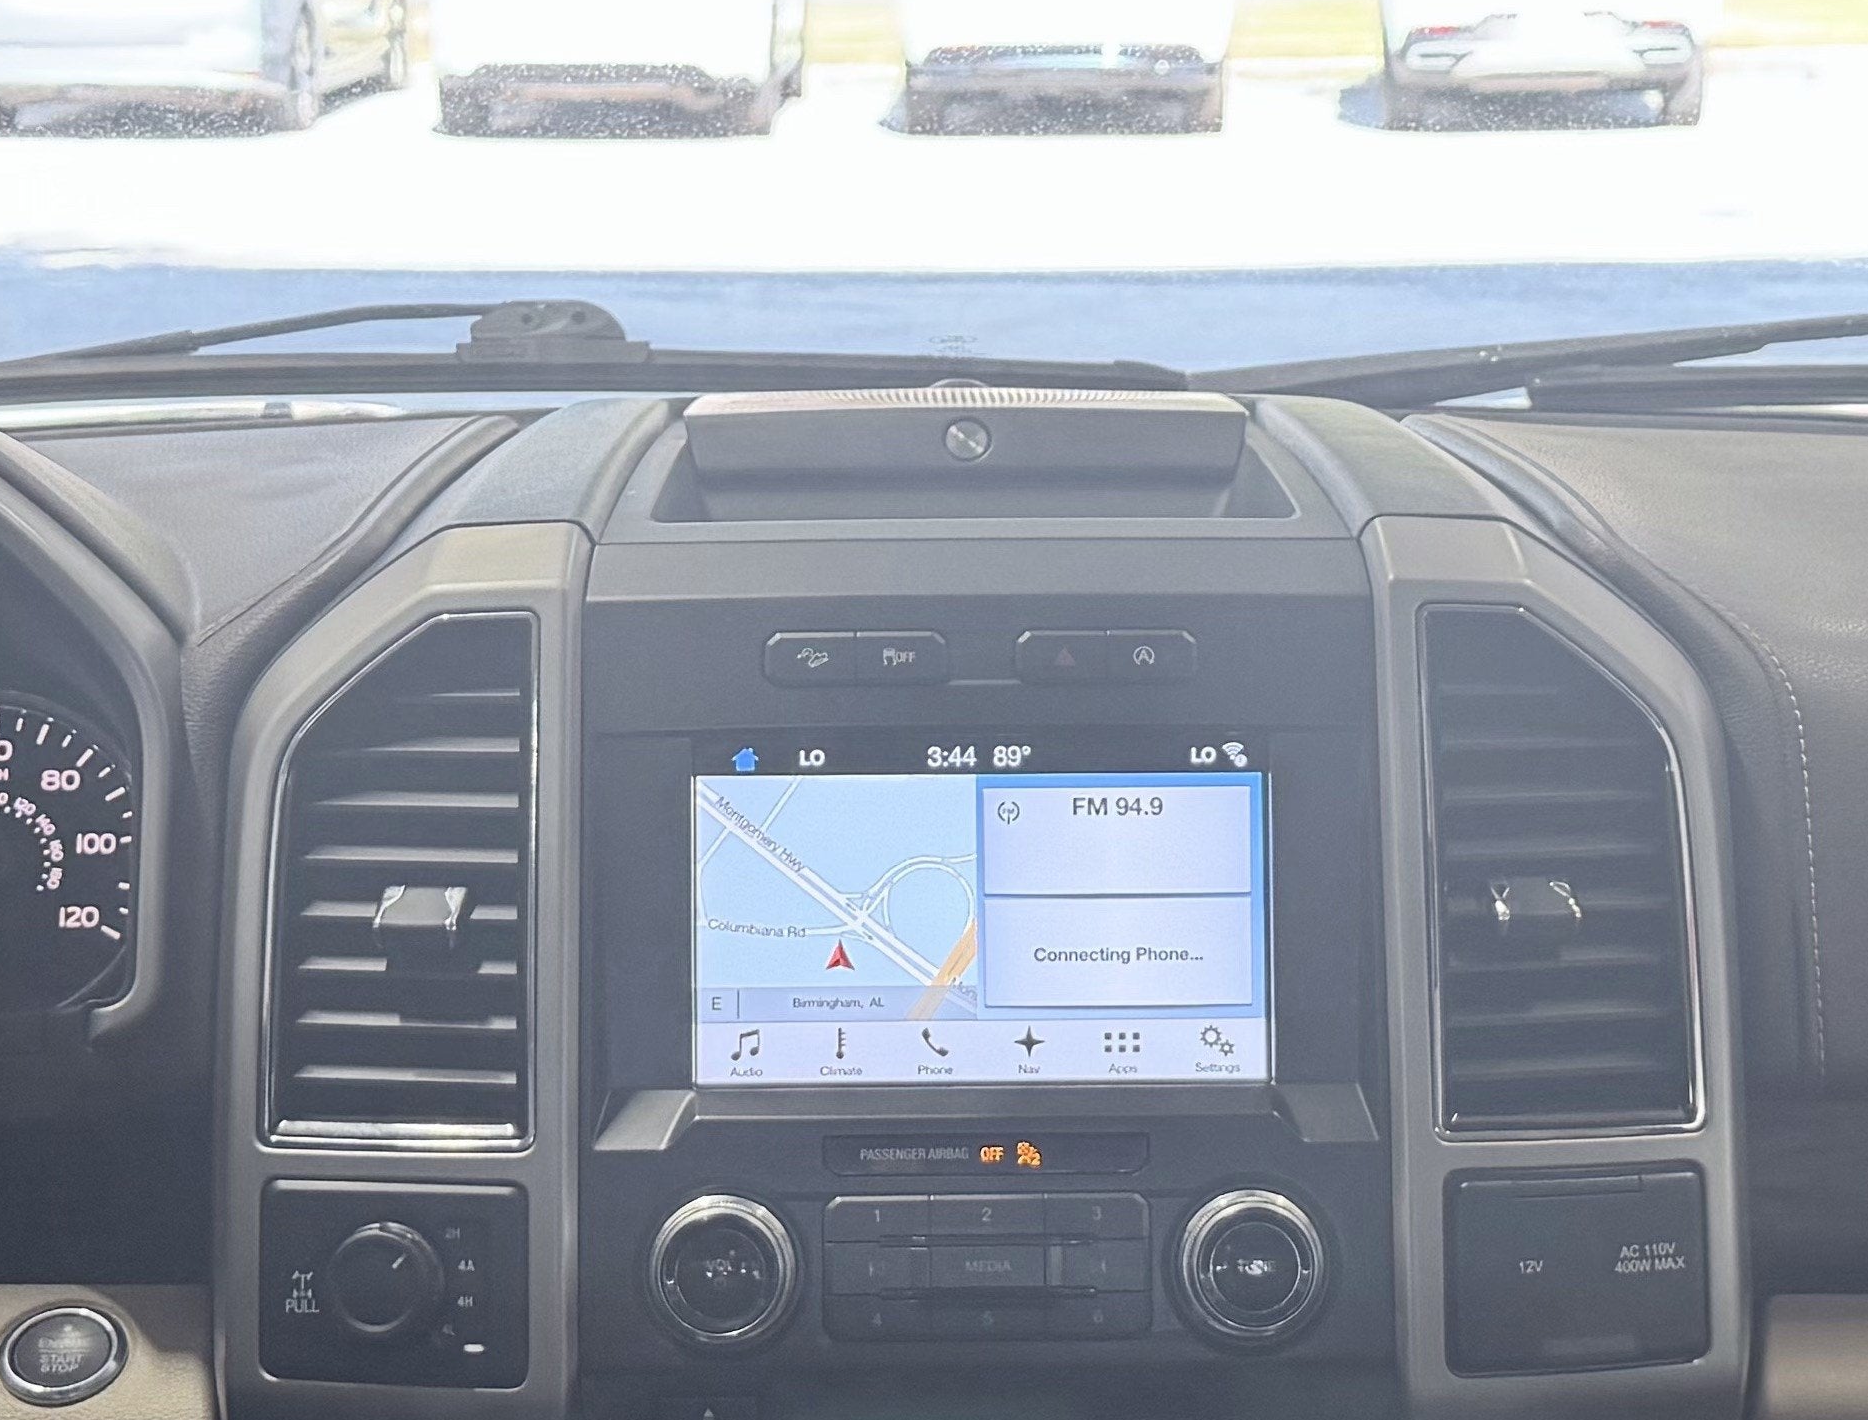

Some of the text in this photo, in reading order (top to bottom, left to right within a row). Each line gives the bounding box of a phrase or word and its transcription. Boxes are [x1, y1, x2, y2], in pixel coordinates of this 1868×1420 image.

[799, 750, 825, 766] LO
[927, 746, 978, 767] 3:44
[1190, 747, 1217, 763] LO
[40, 769, 81, 791] 80
[1072, 797, 1164, 816] FM 94.9
[716, 796, 805, 873] Montgomery Hwy
[75, 833, 117, 854] 100
[59, 906, 100, 928] 120
[708, 919, 807, 938] Columbiana Rd
[1034, 947, 1204, 965] Connecting Phone...
[712, 997, 722, 1011] E
[869, 997, 884, 1009] AL
[730, 1067, 763, 1077] Audio
[820, 1066, 863, 1076] Climate
[917, 1065, 953, 1075] Phone
[1018, 1064, 1040, 1074] Nav
[1108, 1063, 1138, 1074] Apps
[1195, 1061, 1241, 1074] Settings
[860, 1146, 1004, 1161] PASSENGER AIRBAG OFF
[873, 1209, 880, 1222] 1
[981, 1207, 991, 1221] 2
[1092, 1206, 1102, 1220] 3
[1620, 1242, 1676, 1258] AC 110V
[458, 1260, 475, 1272] 4A
[965, 1261, 1011, 1273] MEDIA
[1518, 1261, 1543, 1273] 12V
[1615, 1255, 1685, 1273] 400W MAX
[285, 1298, 320, 1313] PULL
[457, 1297, 473, 1307] 4H
[39, 1354, 84, 1364] START
[40, 1363, 80, 1373] STOP
